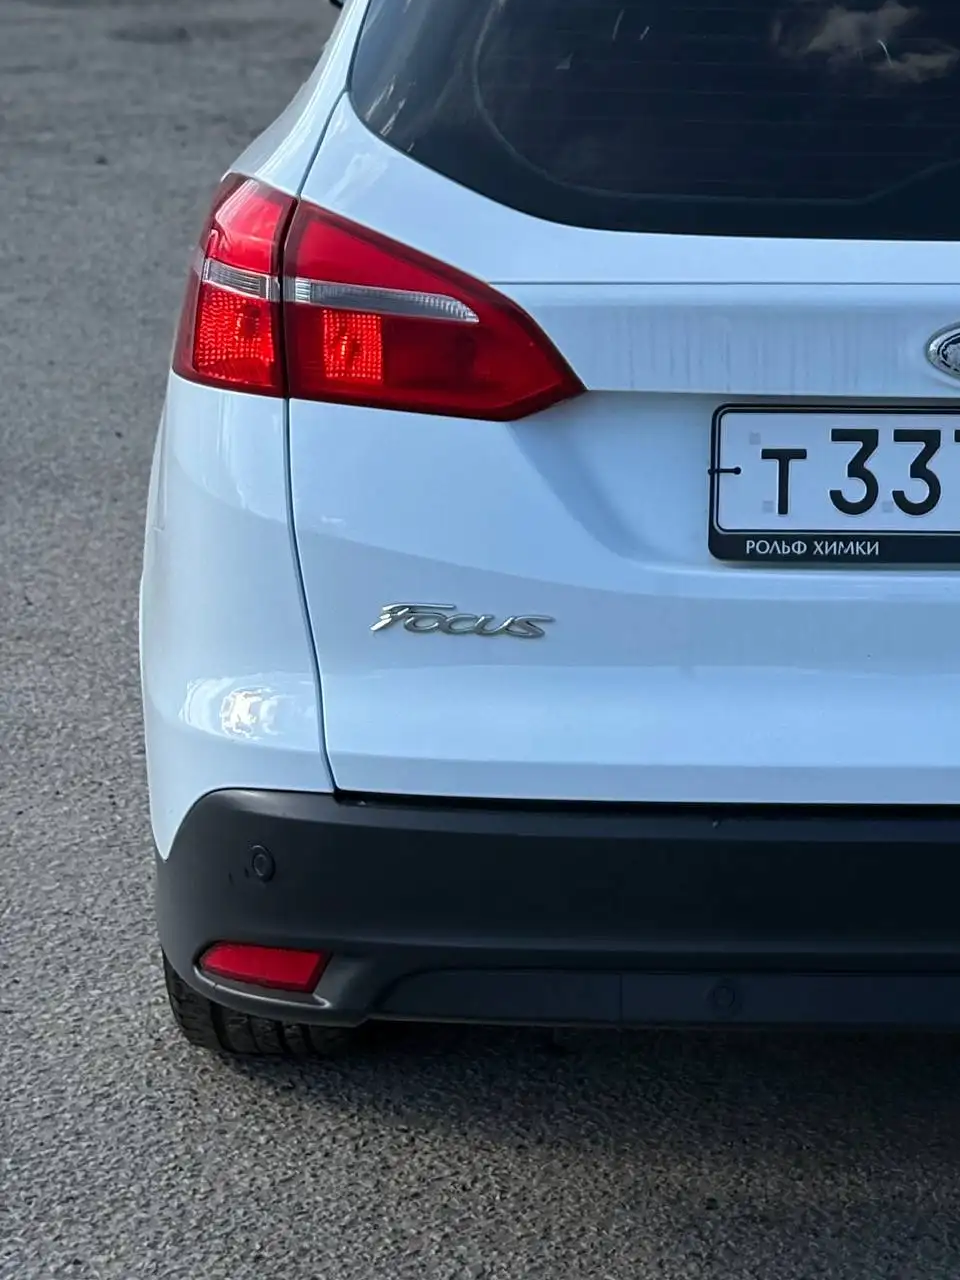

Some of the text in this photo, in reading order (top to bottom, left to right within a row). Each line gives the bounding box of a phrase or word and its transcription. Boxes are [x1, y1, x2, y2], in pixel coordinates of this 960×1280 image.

[745, 539, 880, 556] РОЛЬФ ХИМКИ
[369, 602, 558, 639] Focus
